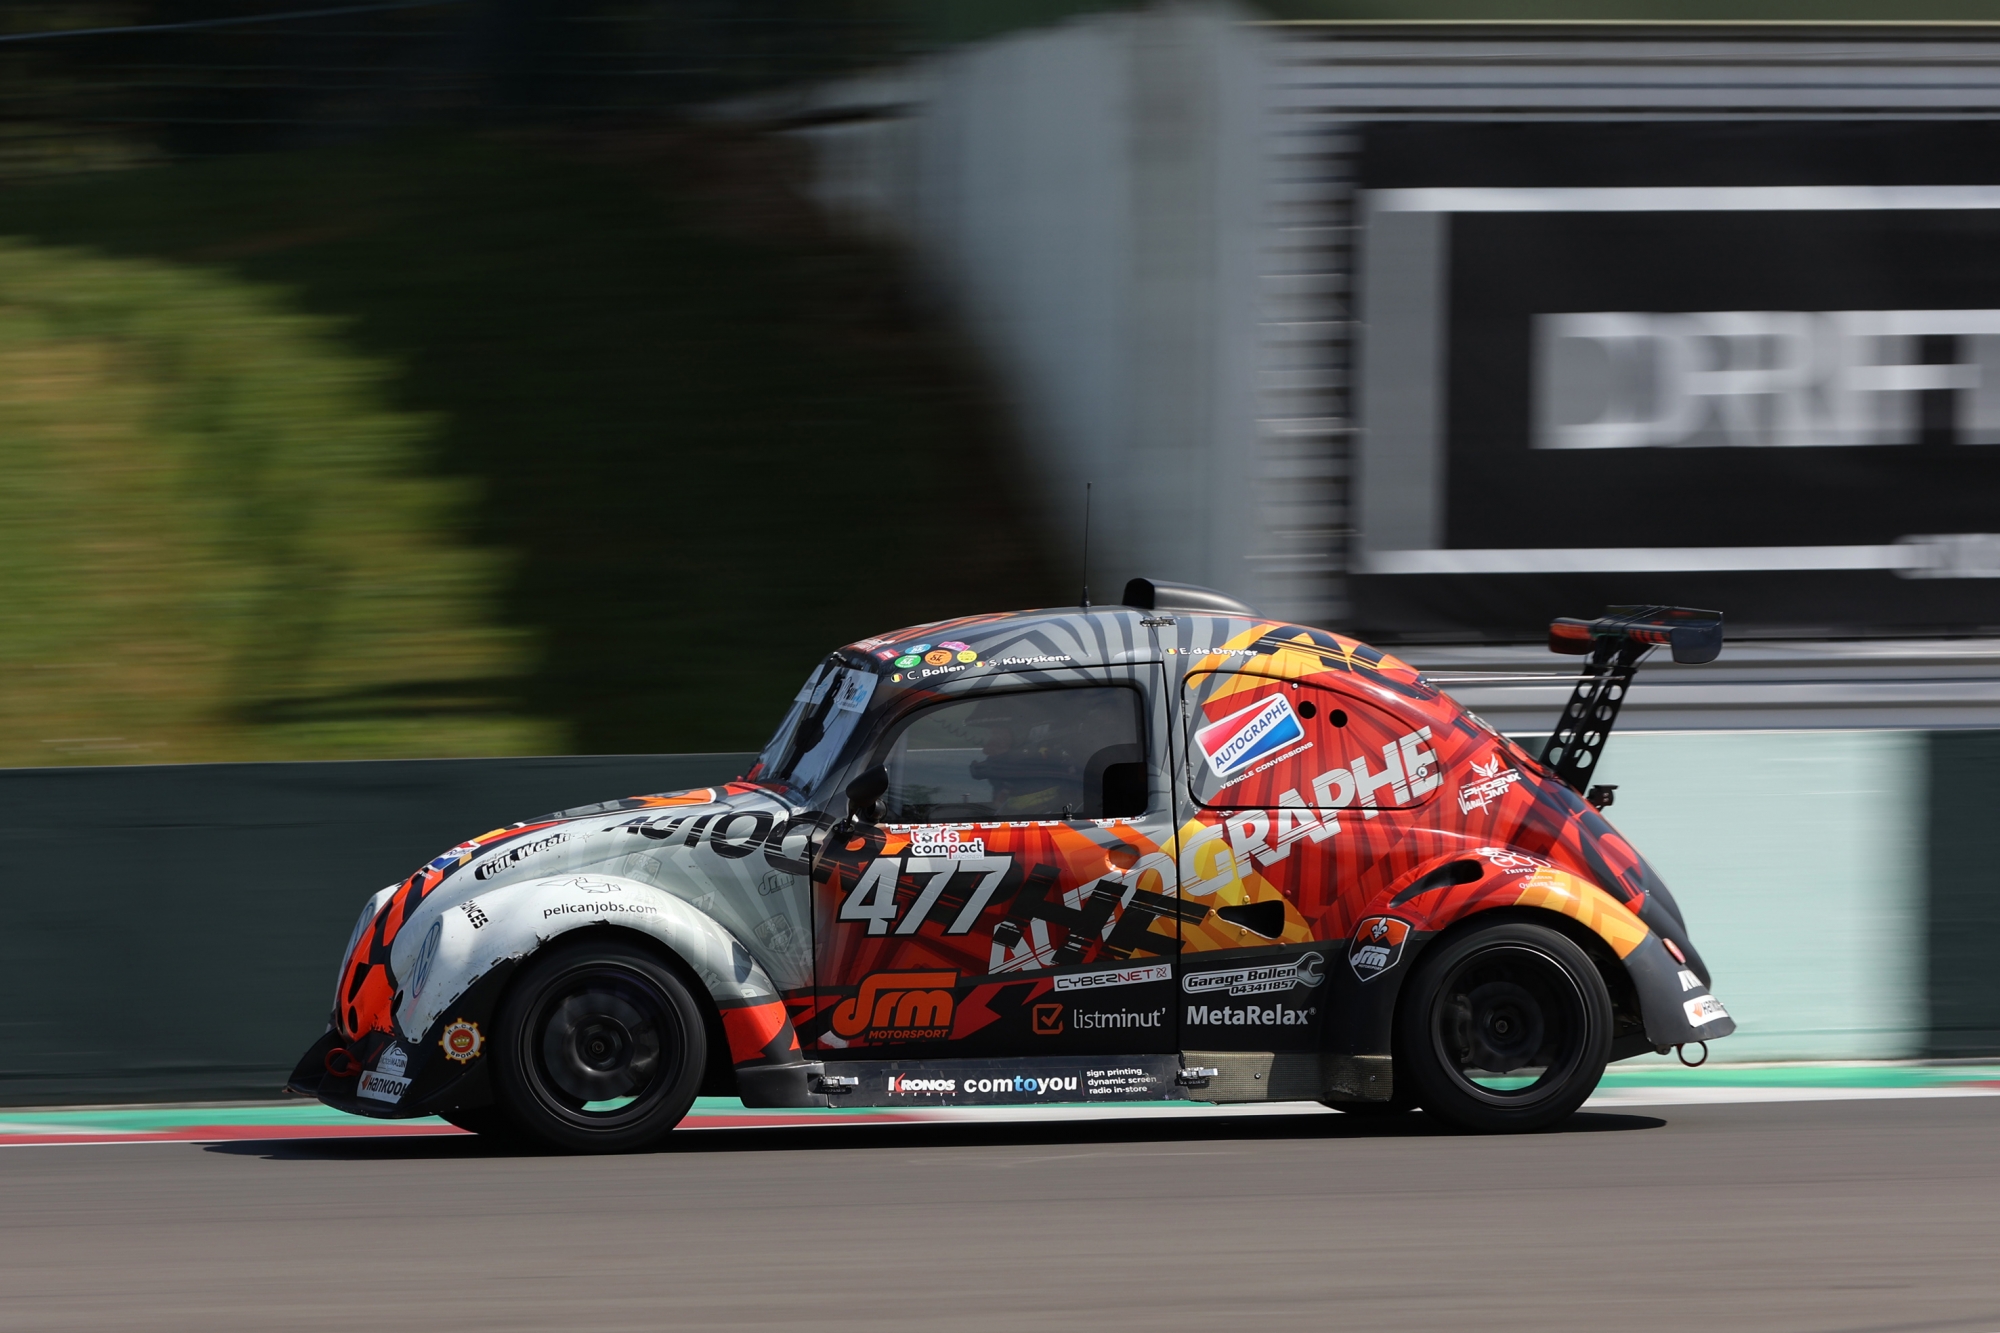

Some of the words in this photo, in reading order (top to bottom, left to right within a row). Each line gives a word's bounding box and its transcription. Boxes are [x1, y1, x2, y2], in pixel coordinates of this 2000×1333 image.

[989, 659, 1001, 667] S.
[1002, 653, 1072, 667] Kluyskens
[1179, 647, 1191, 655] E.
[1193, 647, 1210, 655] de
[1211, 648, 1258, 656] Dryver
[906, 670, 920, 681] C.
[922, 663, 966, 678] Bollen
[1214, 699, 1289, 770] AUTOGRAPHE
[1220, 769, 1255, 790] VEHICLE
[1256, 741, 1314, 774] CONVERSIONS
[1463, 772, 1522, 800] PHOENIX
[516, 831, 571, 860] Wash
[914, 839, 983, 859] compact
[839, 855, 1013, 935] 477
[543, 900, 658, 919] pelicanjobs.com
[1187, 974, 1245, 988] Garage
[1247, 968, 1296, 981] Bollen
[1231, 980, 1297, 995] 043411857
[868, 1029, 949, 1040] MOTORSPORT
[449, 1049, 476, 1059] SPORT
[1086, 1069, 1105, 1078] sign
[1107, 1067, 1143, 1077] printing
[1087, 1077, 1127, 1087] dynamic
[1128, 1076, 1157, 1084] screen
[887, 1072, 956, 1093] KRONOS
[963, 1075, 1078, 1095] comtoyou
[1089, 1086, 1112, 1095] radio
[1113, 1085, 1148, 1093] in-store
